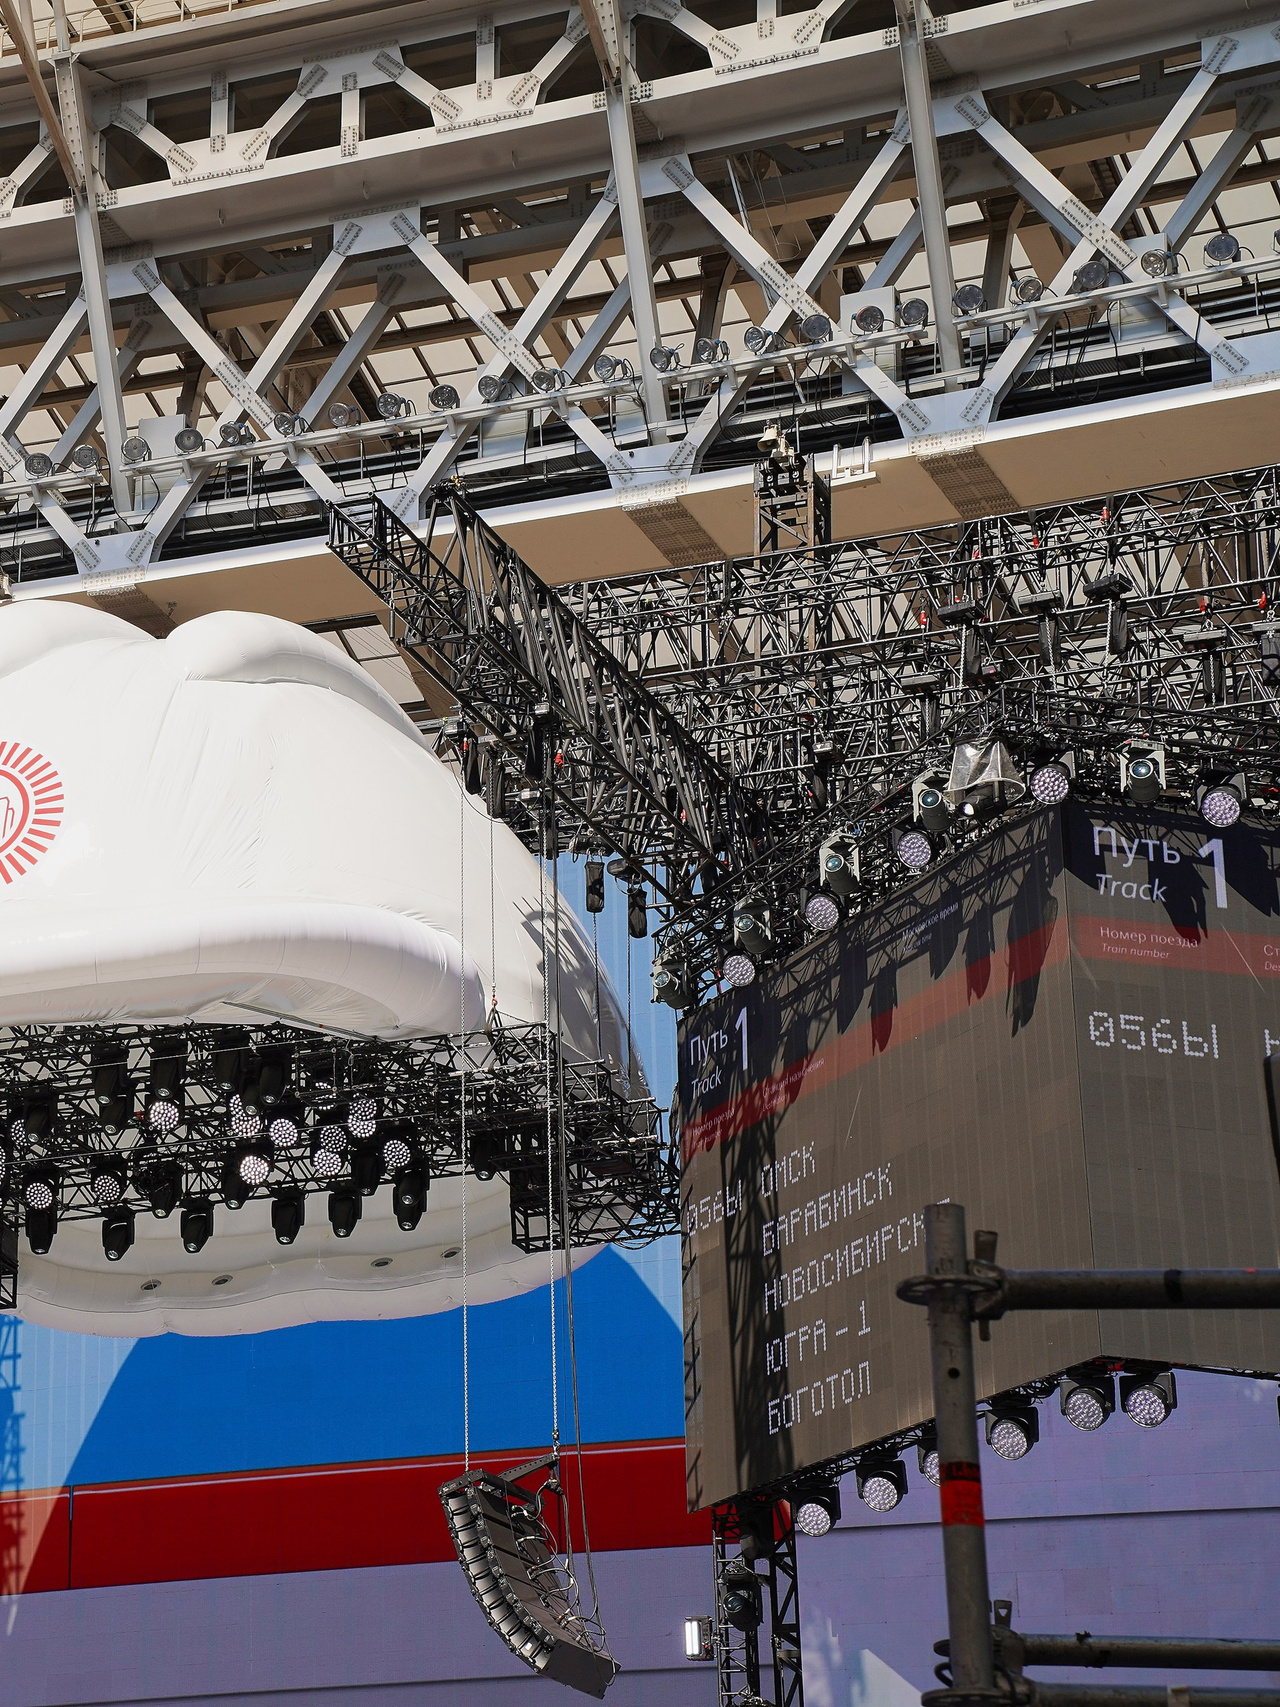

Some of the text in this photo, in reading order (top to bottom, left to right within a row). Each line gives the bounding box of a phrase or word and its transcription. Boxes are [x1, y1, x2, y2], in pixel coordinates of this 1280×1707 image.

[1093, 826, 1228, 909] Путь 1
[1096, 873, 1168, 902] Track
[1100, 927, 1198, 949] Номер поезда
[1102, 943, 1169, 959] Train number
[690, 1006, 748, 1071] Путь 1
[1088, 1011, 1219, 1059] 056Ы
[691, 1067, 722, 1100] Track
[761, 1141, 816, 1198] ОМСК
[686, 1179, 742, 1237] 056Ы
[763, 1162, 892, 1256] БАРАБИНСК
[766, 1318, 826, 1376] ЮГРА
[858, 1300, 871, 1336] 1
[768, 1361, 871, 1435] БОГОТОЛ
